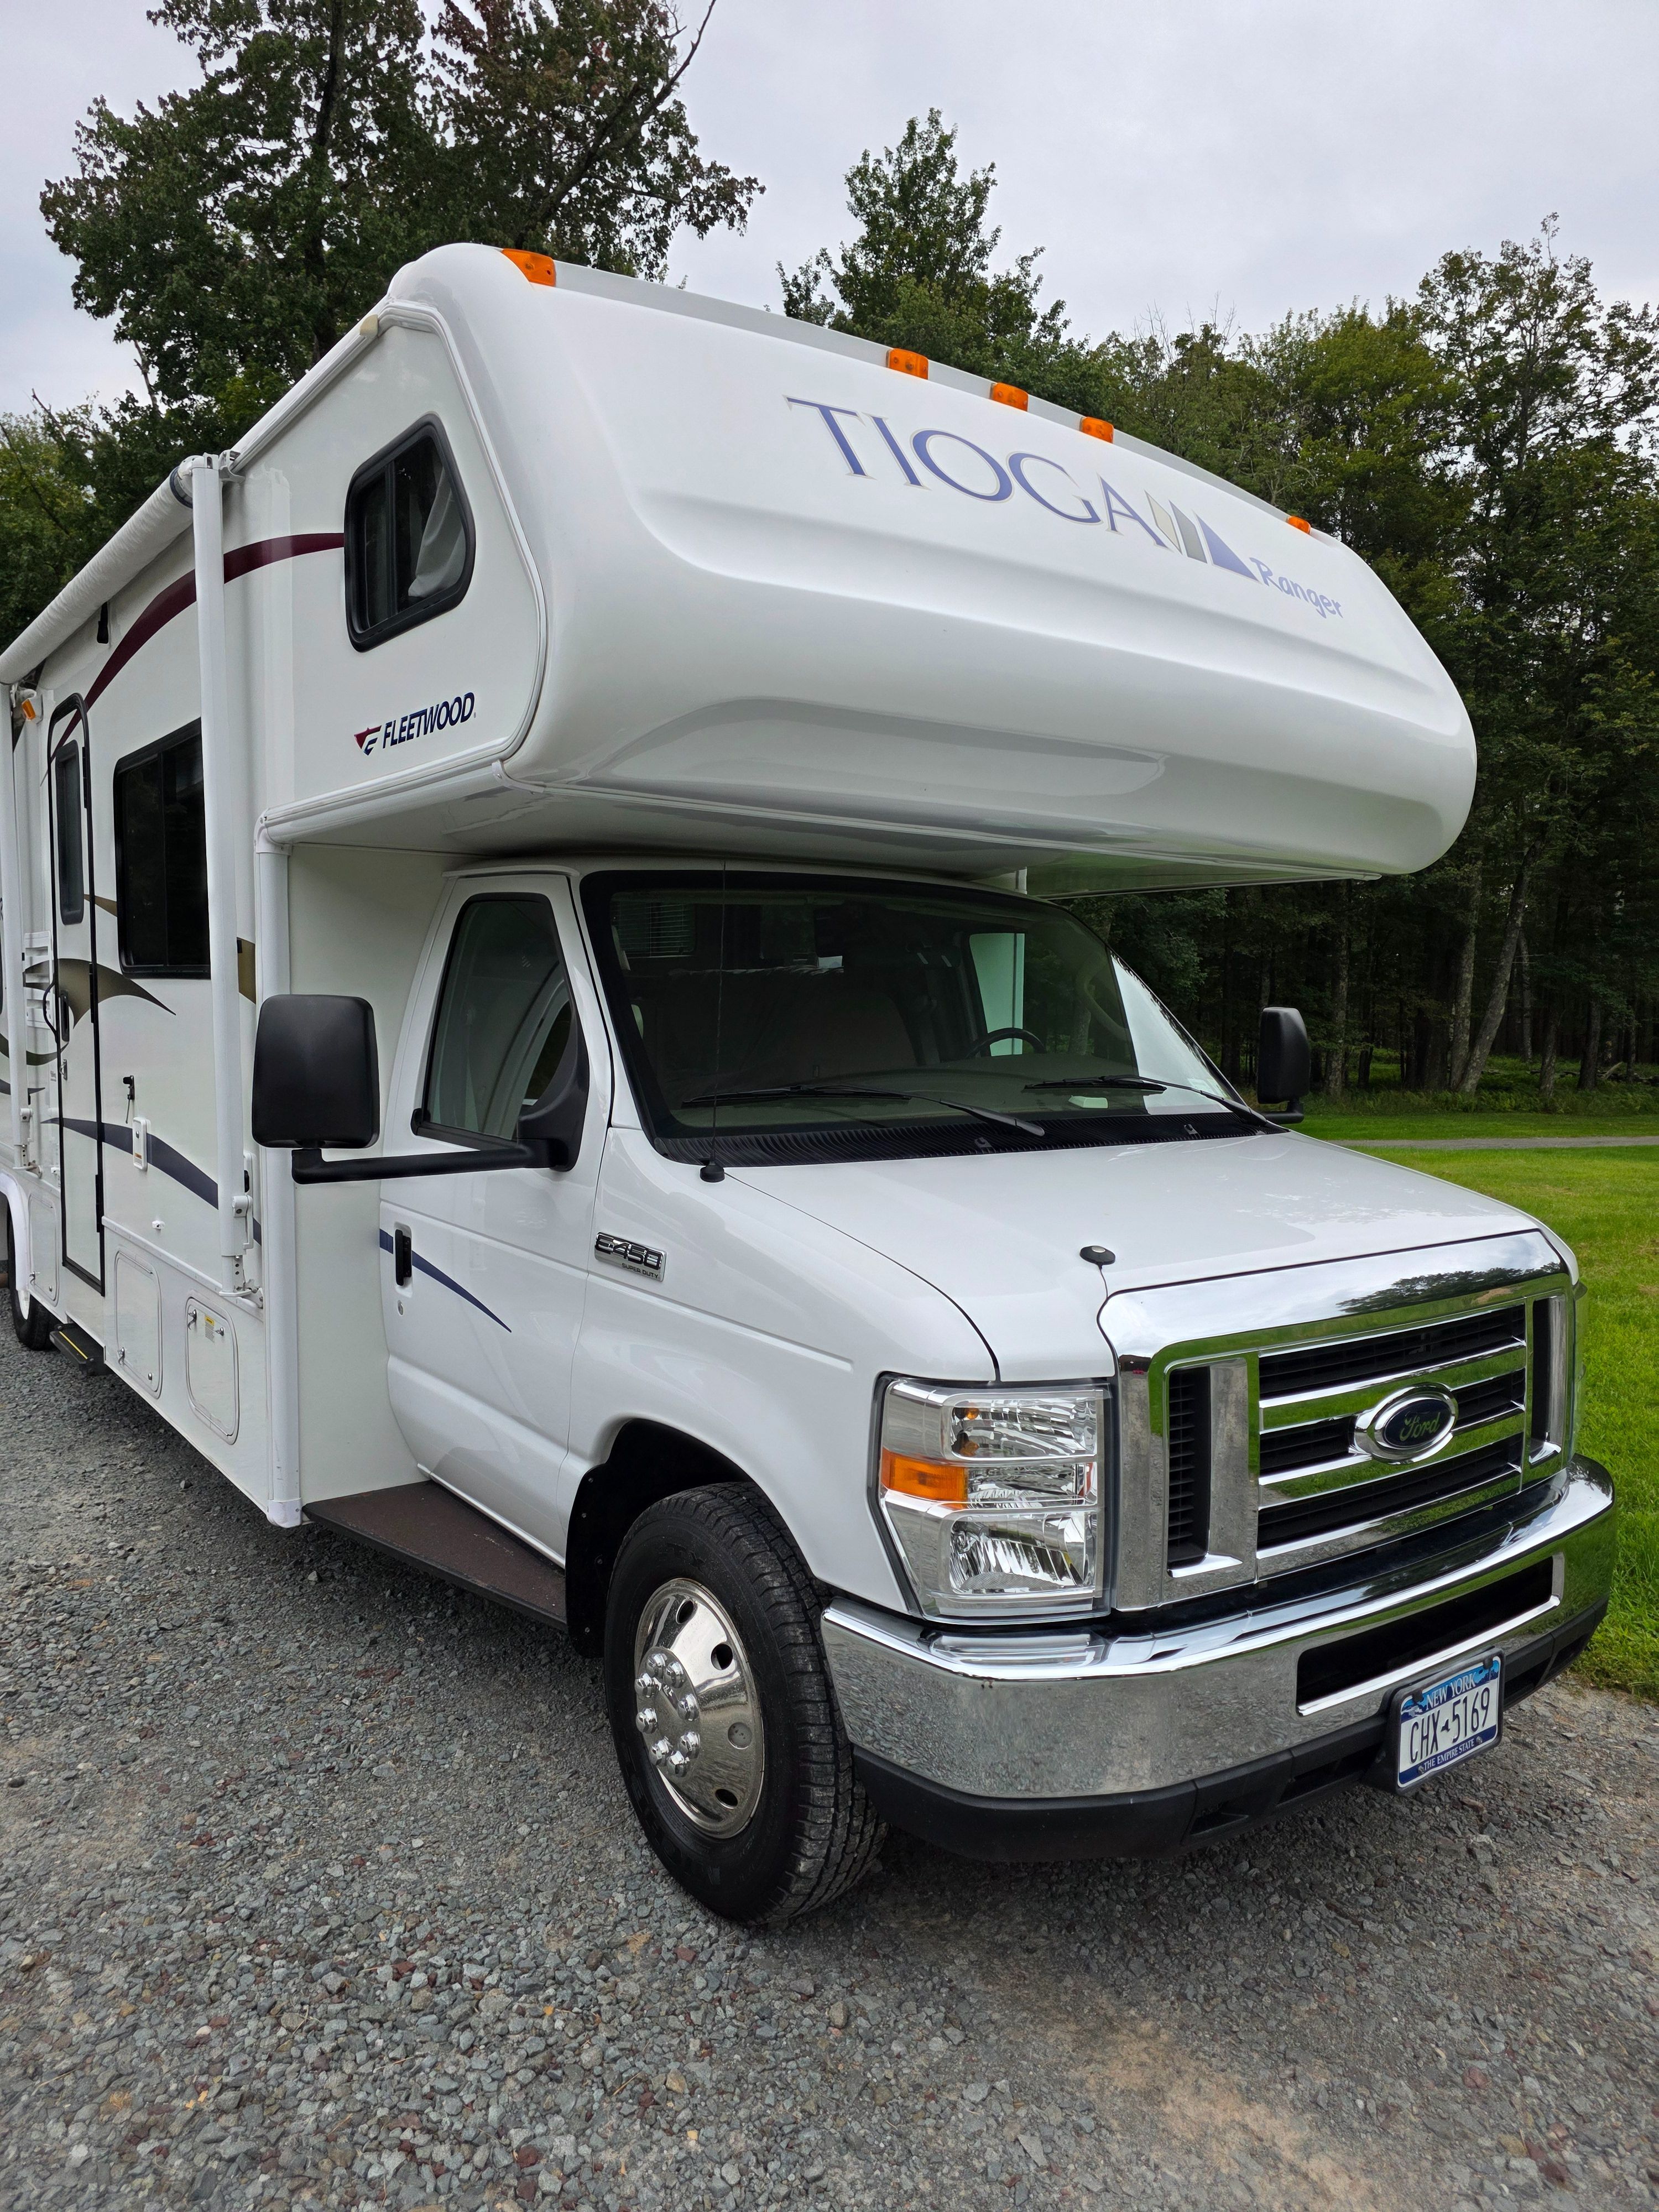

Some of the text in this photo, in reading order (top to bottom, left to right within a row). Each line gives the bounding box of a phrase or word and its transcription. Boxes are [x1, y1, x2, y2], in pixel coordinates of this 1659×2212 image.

[782, 395, 1168, 548] TIOGA
[1249, 557, 1343, 619] Ranger
[383, 692, 475, 749] FLEETWOOD
[622, 1263, 659, 1279] SUPER DUTY
[1399, 1411, 1441, 1442] Ford
[1426, 1673, 1476, 1710] NEW YORK
[1423, 1739, 1475, 1771] THE EMPIRE STATE
